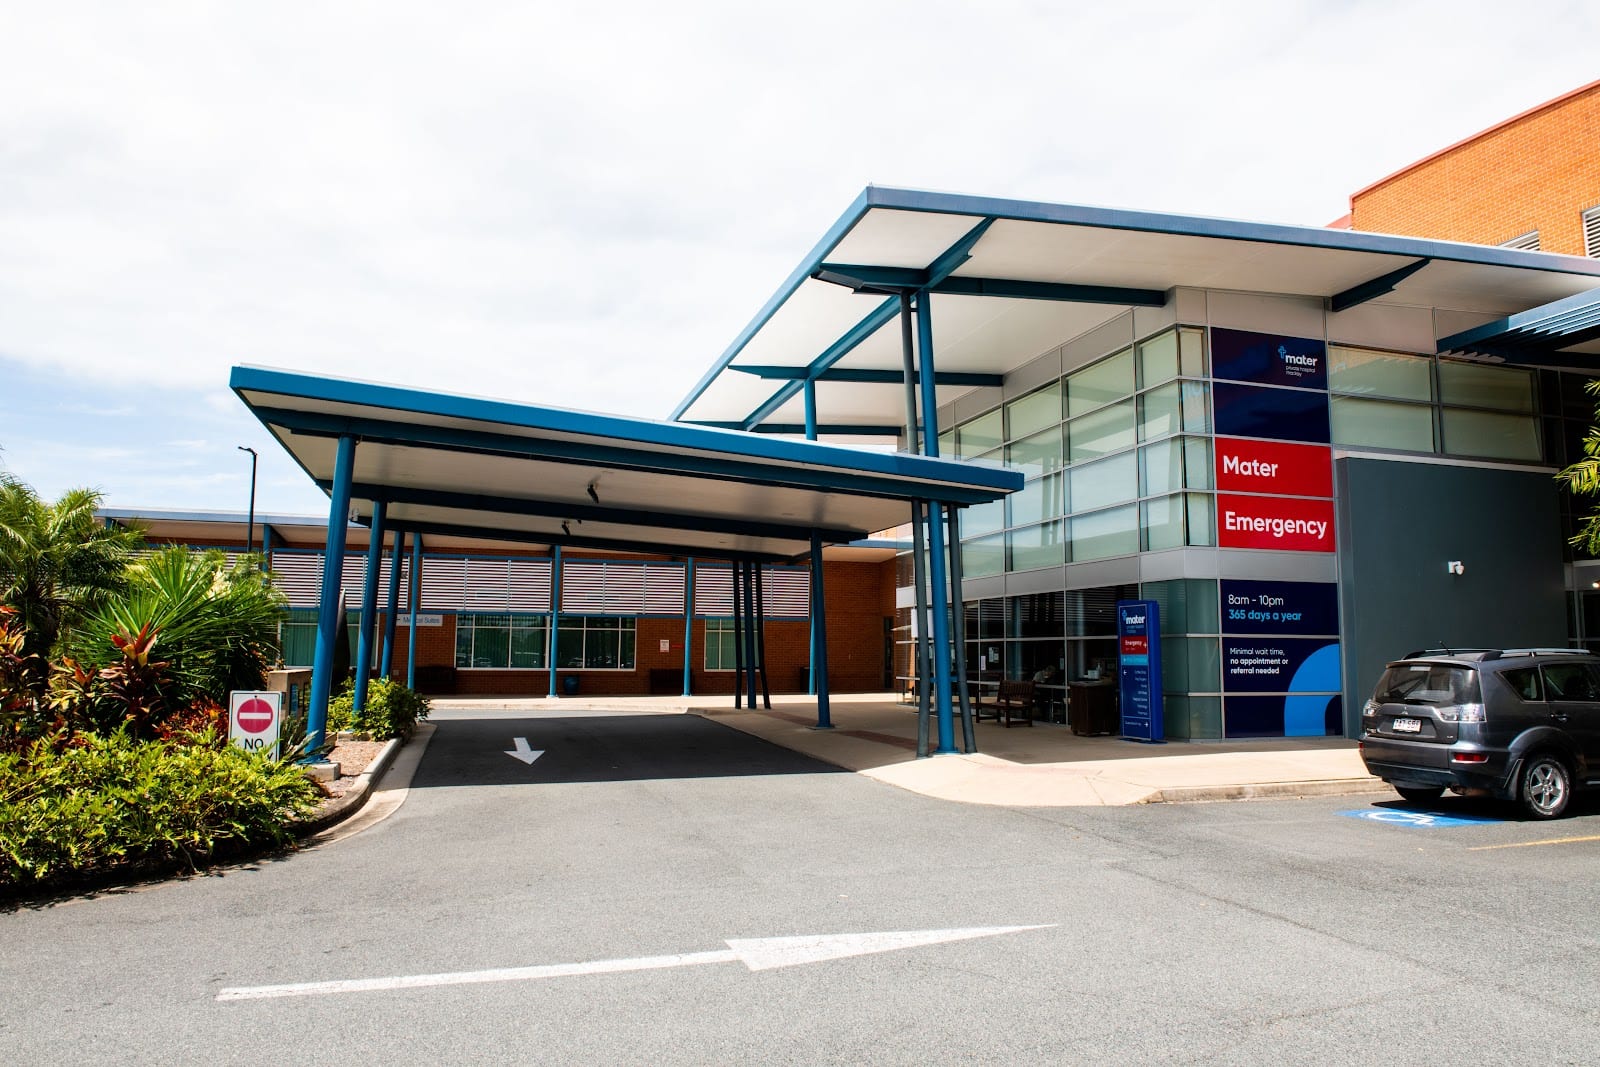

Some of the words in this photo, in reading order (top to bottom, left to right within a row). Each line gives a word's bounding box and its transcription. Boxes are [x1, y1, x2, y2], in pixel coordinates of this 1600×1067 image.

[1285, 354, 1318, 367] mater
[1223, 455, 1278, 477] Mater
[1225, 510, 1327, 539] Emergency
[1228, 594, 1250, 605] 8am
[1259, 595, 1284, 607] 10pm
[1125, 614, 1146, 625] mater
[1228, 609, 1246, 620] 365
[1248, 610, 1271, 622] days
[1272, 612, 1279, 620] a
[1281, 612, 1302, 623] year
[1269, 648, 1286, 656] time,
[1240, 657, 1281, 666] appointment
[244, 738, 264, 750] NO
